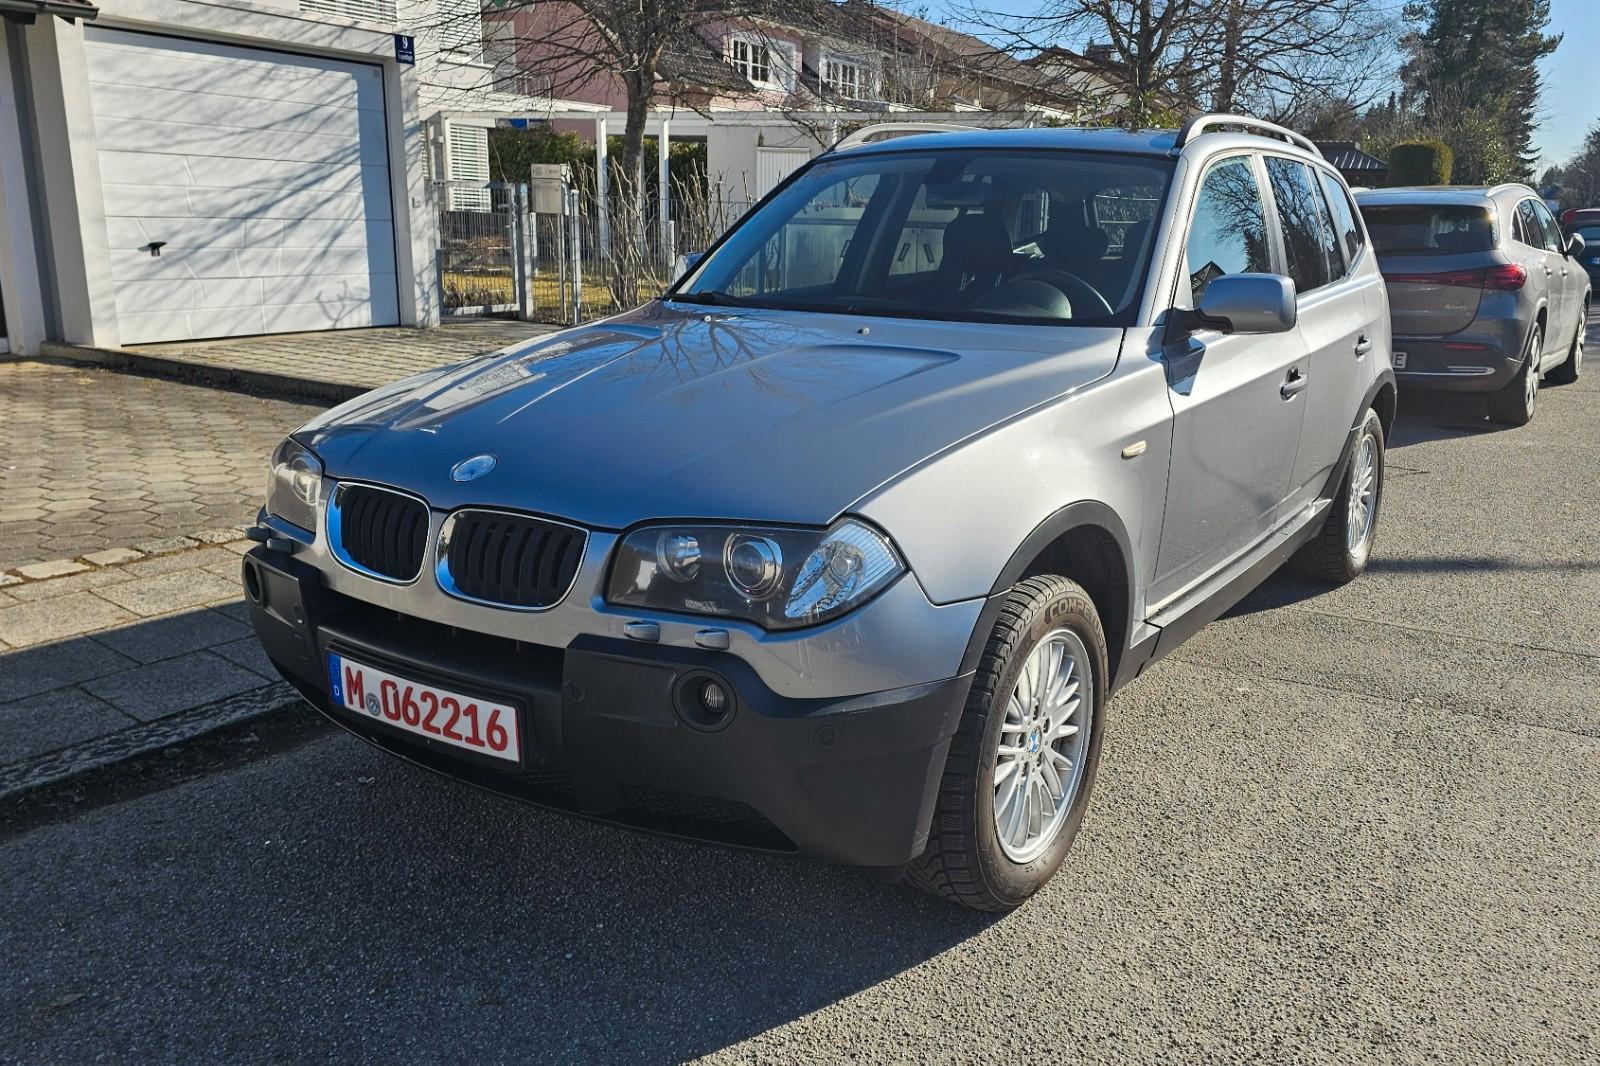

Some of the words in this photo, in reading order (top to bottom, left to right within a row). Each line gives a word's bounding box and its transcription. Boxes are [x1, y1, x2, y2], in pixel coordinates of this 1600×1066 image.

[402, 36, 408, 48] 9
[345, 665, 365, 709] M
[380, 679, 508, 751] 062216
